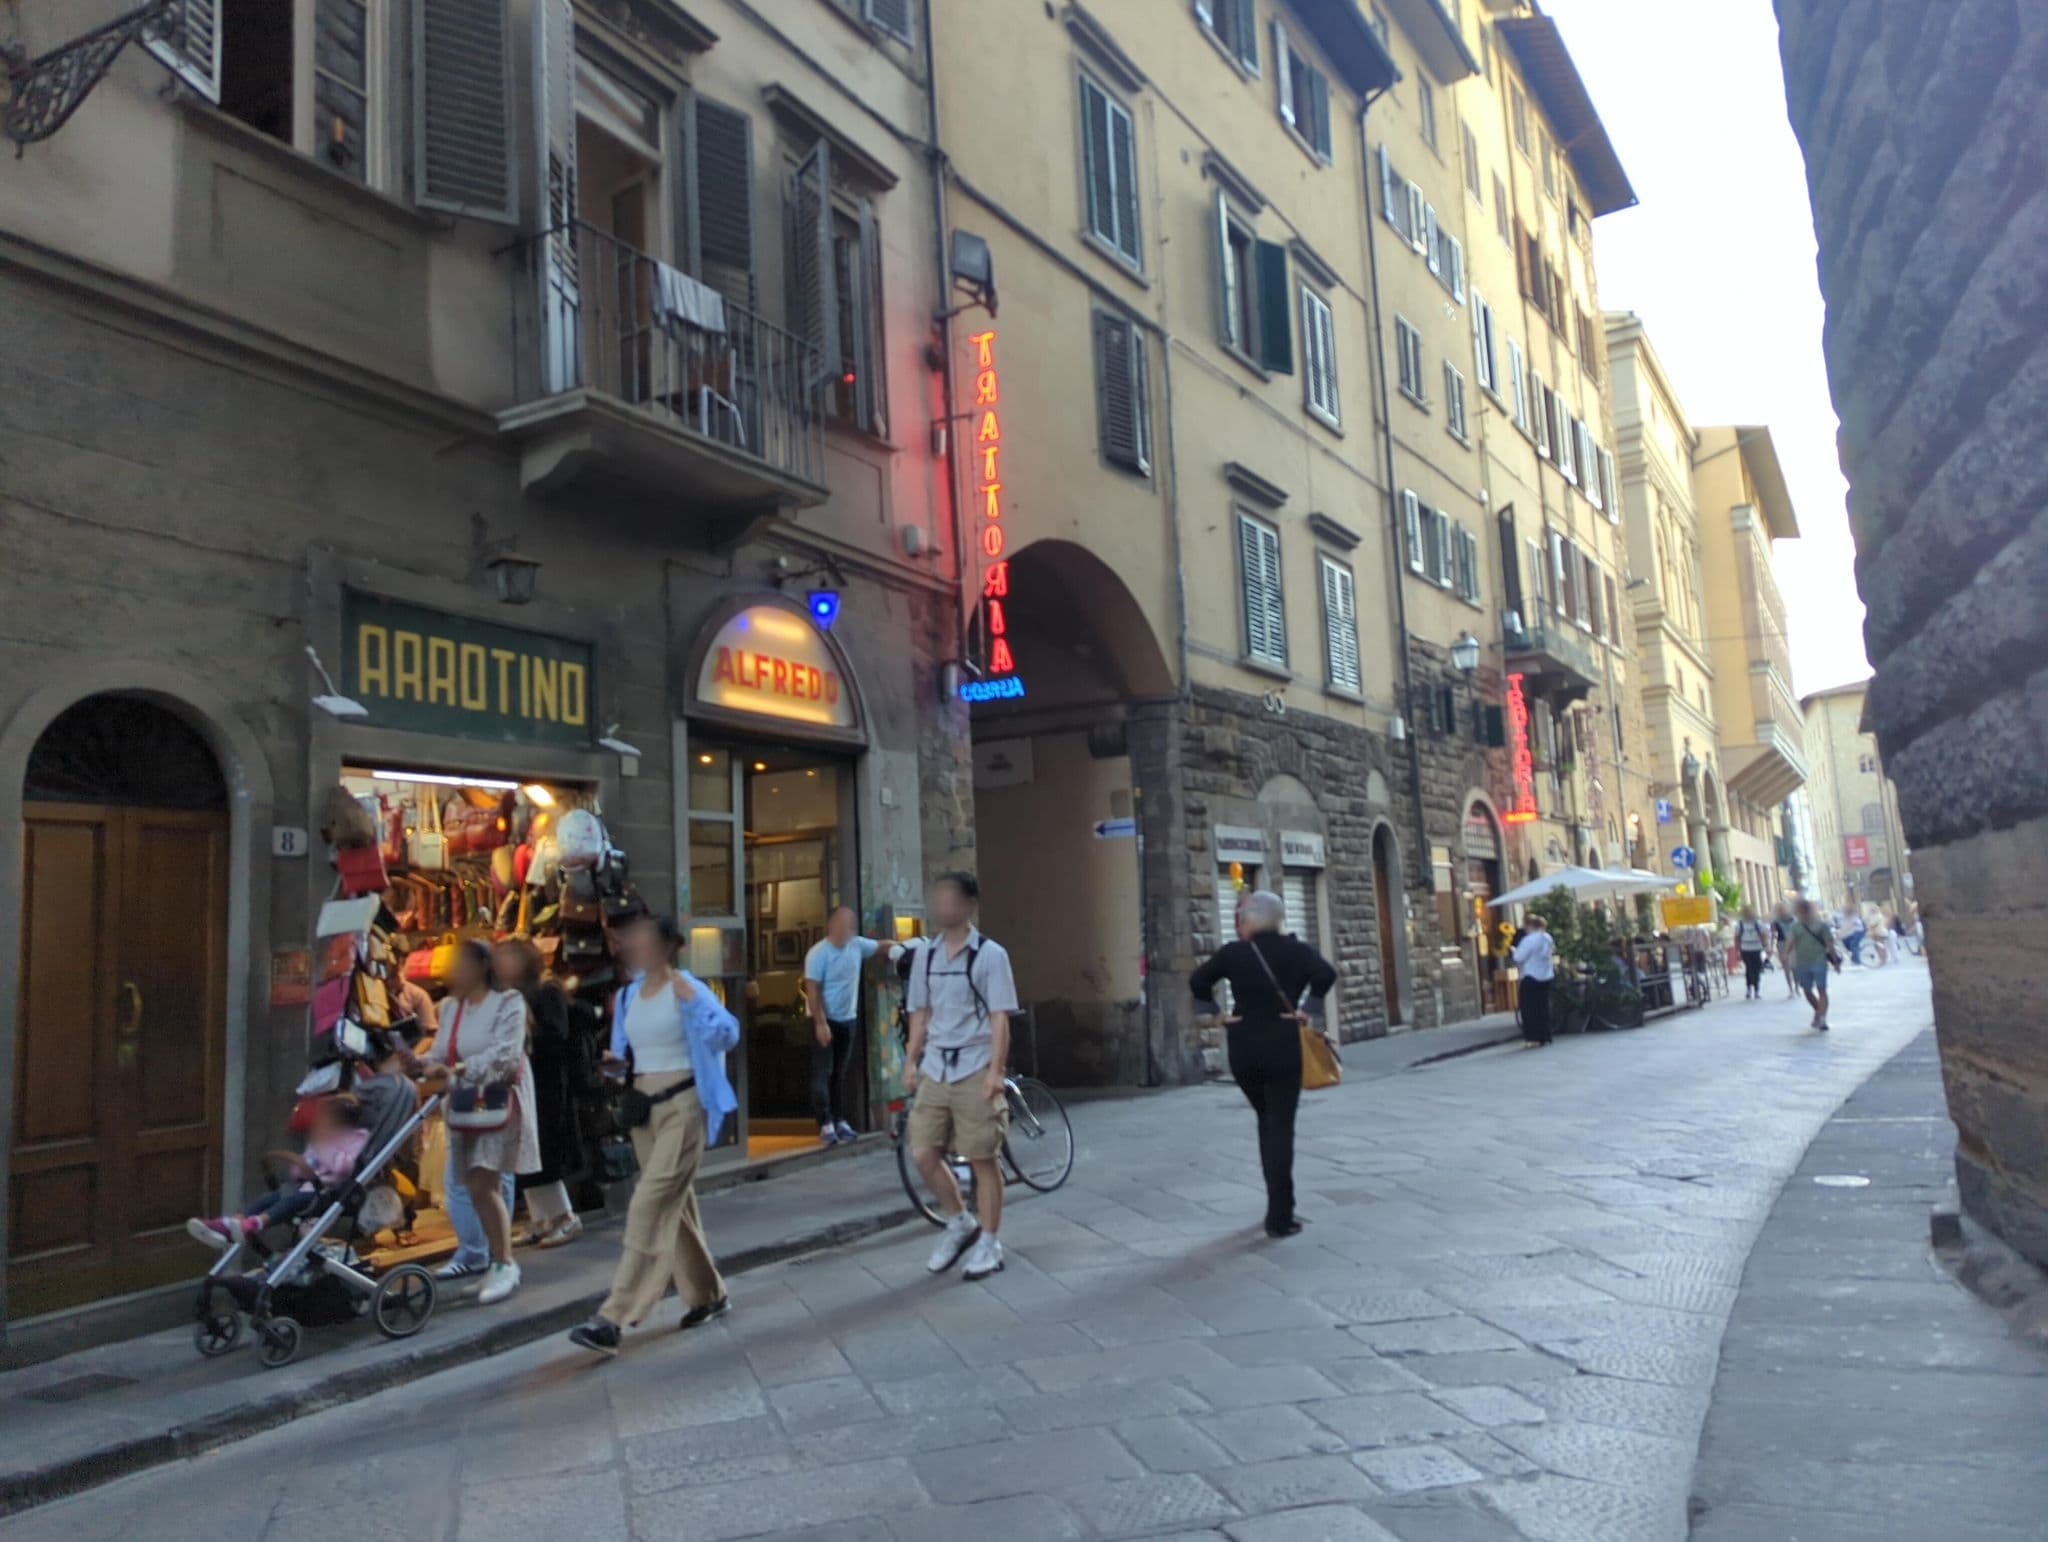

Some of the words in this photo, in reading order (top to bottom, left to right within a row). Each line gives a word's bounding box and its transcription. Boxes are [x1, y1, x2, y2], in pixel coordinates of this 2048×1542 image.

[358, 623, 586, 726] ARROTINO
[713, 645, 840, 705] ALFREDO
[281, 831, 295, 853] 8
